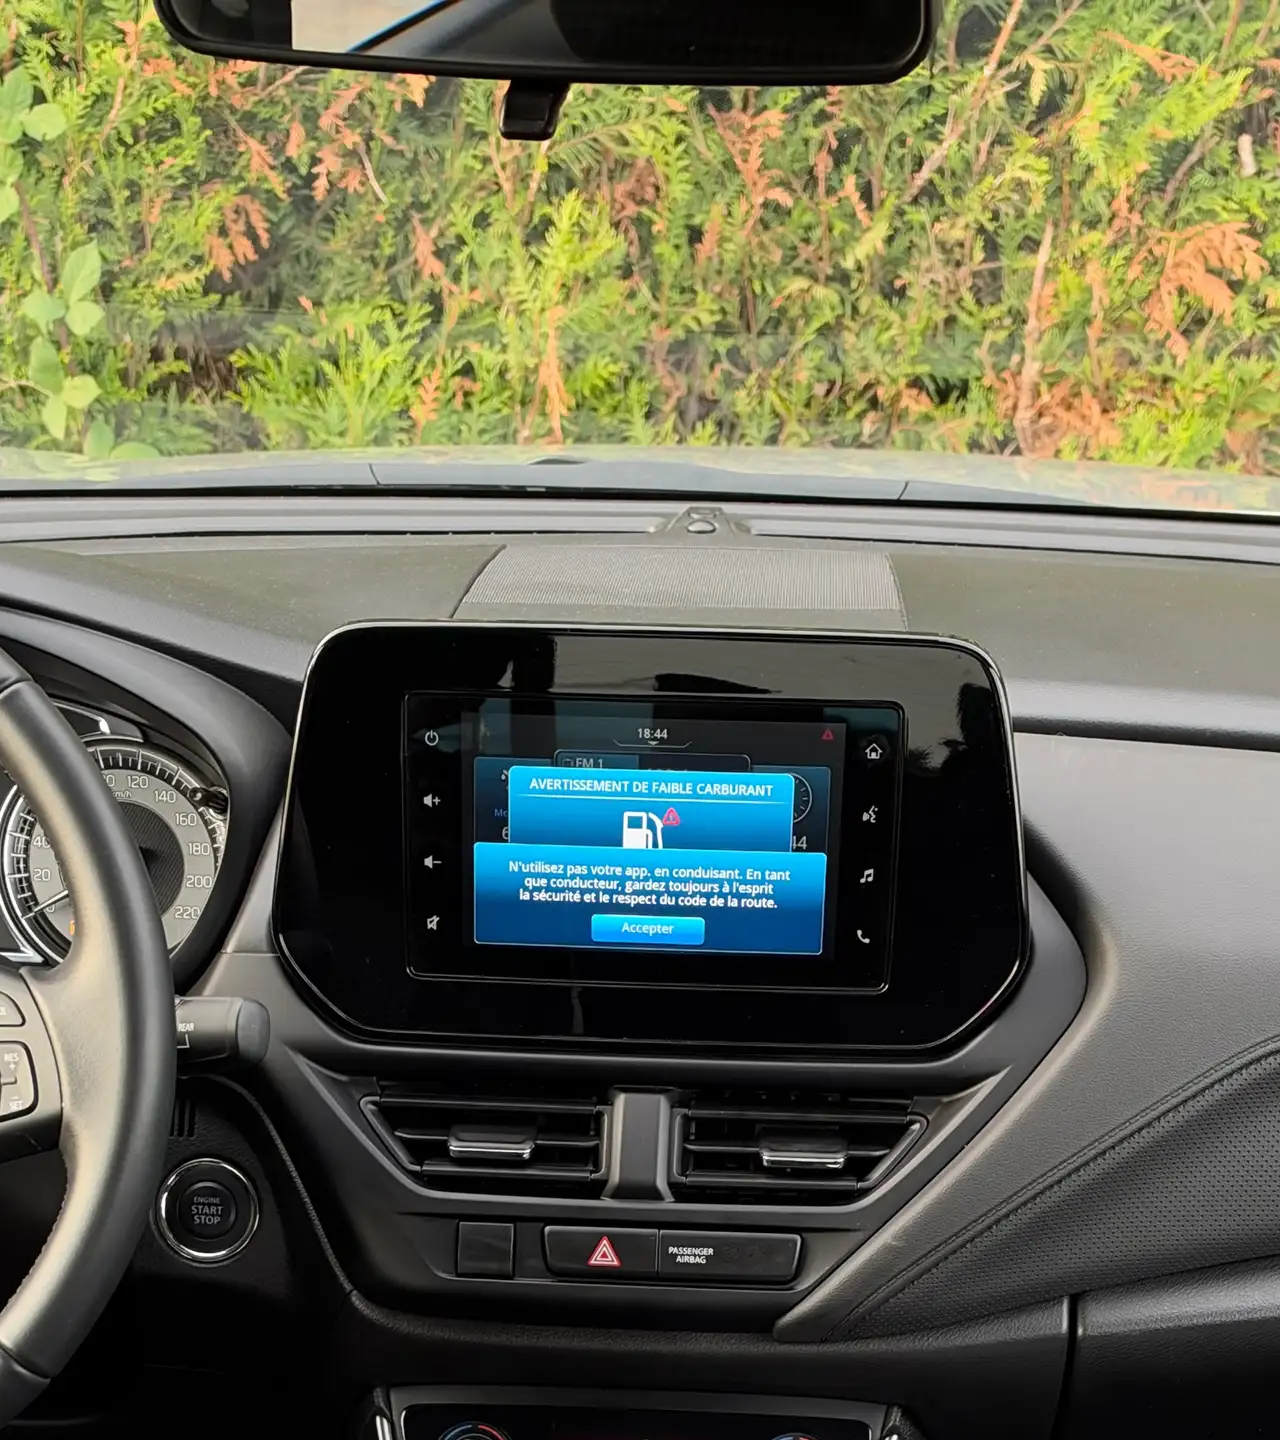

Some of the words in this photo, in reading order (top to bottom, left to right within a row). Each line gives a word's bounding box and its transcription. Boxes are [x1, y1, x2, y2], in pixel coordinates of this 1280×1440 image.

[637, 728, 668, 739] 18:44
[126, 776, 149, 788] 120
[529, 778, 629, 793] AVERTISSEMENT
[633, 781, 649, 793] DE
[652, 782, 693, 795] FAIBLE
[696, 783, 774, 797] CARBURANT
[154, 790, 177, 803] 140
[174, 812, 197, 826] 160
[188, 842, 210, 856] 180
[34, 868, 51, 881] 20
[508, 860, 564, 875] N'utilisez
[567, 865, 588, 877] pas
[590, 864, 623, 876] votre
[624, 866, 651, 879] app.
[654, 868, 670, 878] en
[672, 867, 743, 880] conduisant.
[746, 868, 762, 881] En
[764, 870, 791, 881] tant
[186, 876, 212, 889] 200
[524, 878, 548, 891] que
[550, 877, 622, 892] conducteur,
[625, 880, 666, 893] gardez
[668, 880, 720, 894] toujours
[722, 882, 730, 893] à
[732, 882, 774, 896] l'esprit
[520, 888, 531, 900] la
[532, 888, 581, 902] sécurité
[583, 892, 597, 903] et
[599, 891, 610, 903] le
[612, 893, 658, 907] respect
[660, 893, 676, 905] du
[678, 894, 707, 906] code
[709, 896, 725, 907] de
[727, 896, 738, 907] la
[740, 897, 778, 909] route.
[174, 906, 200, 919] 220
[622, 922, 674, 936] Accepter
[178, 1022, 195, 1032] REAR
[4, 1052, 20, 1062] RES
[9, 1101, 24, 1110] SET
[193, 1196, 221, 1204] ENGINE
[191, 1205, 223, 1215] START
[194, 1215, 221, 1225] STOP
[668, 1246, 714, 1256] PASSENGER
[676, 1256, 707, 1264] AIRBAG
